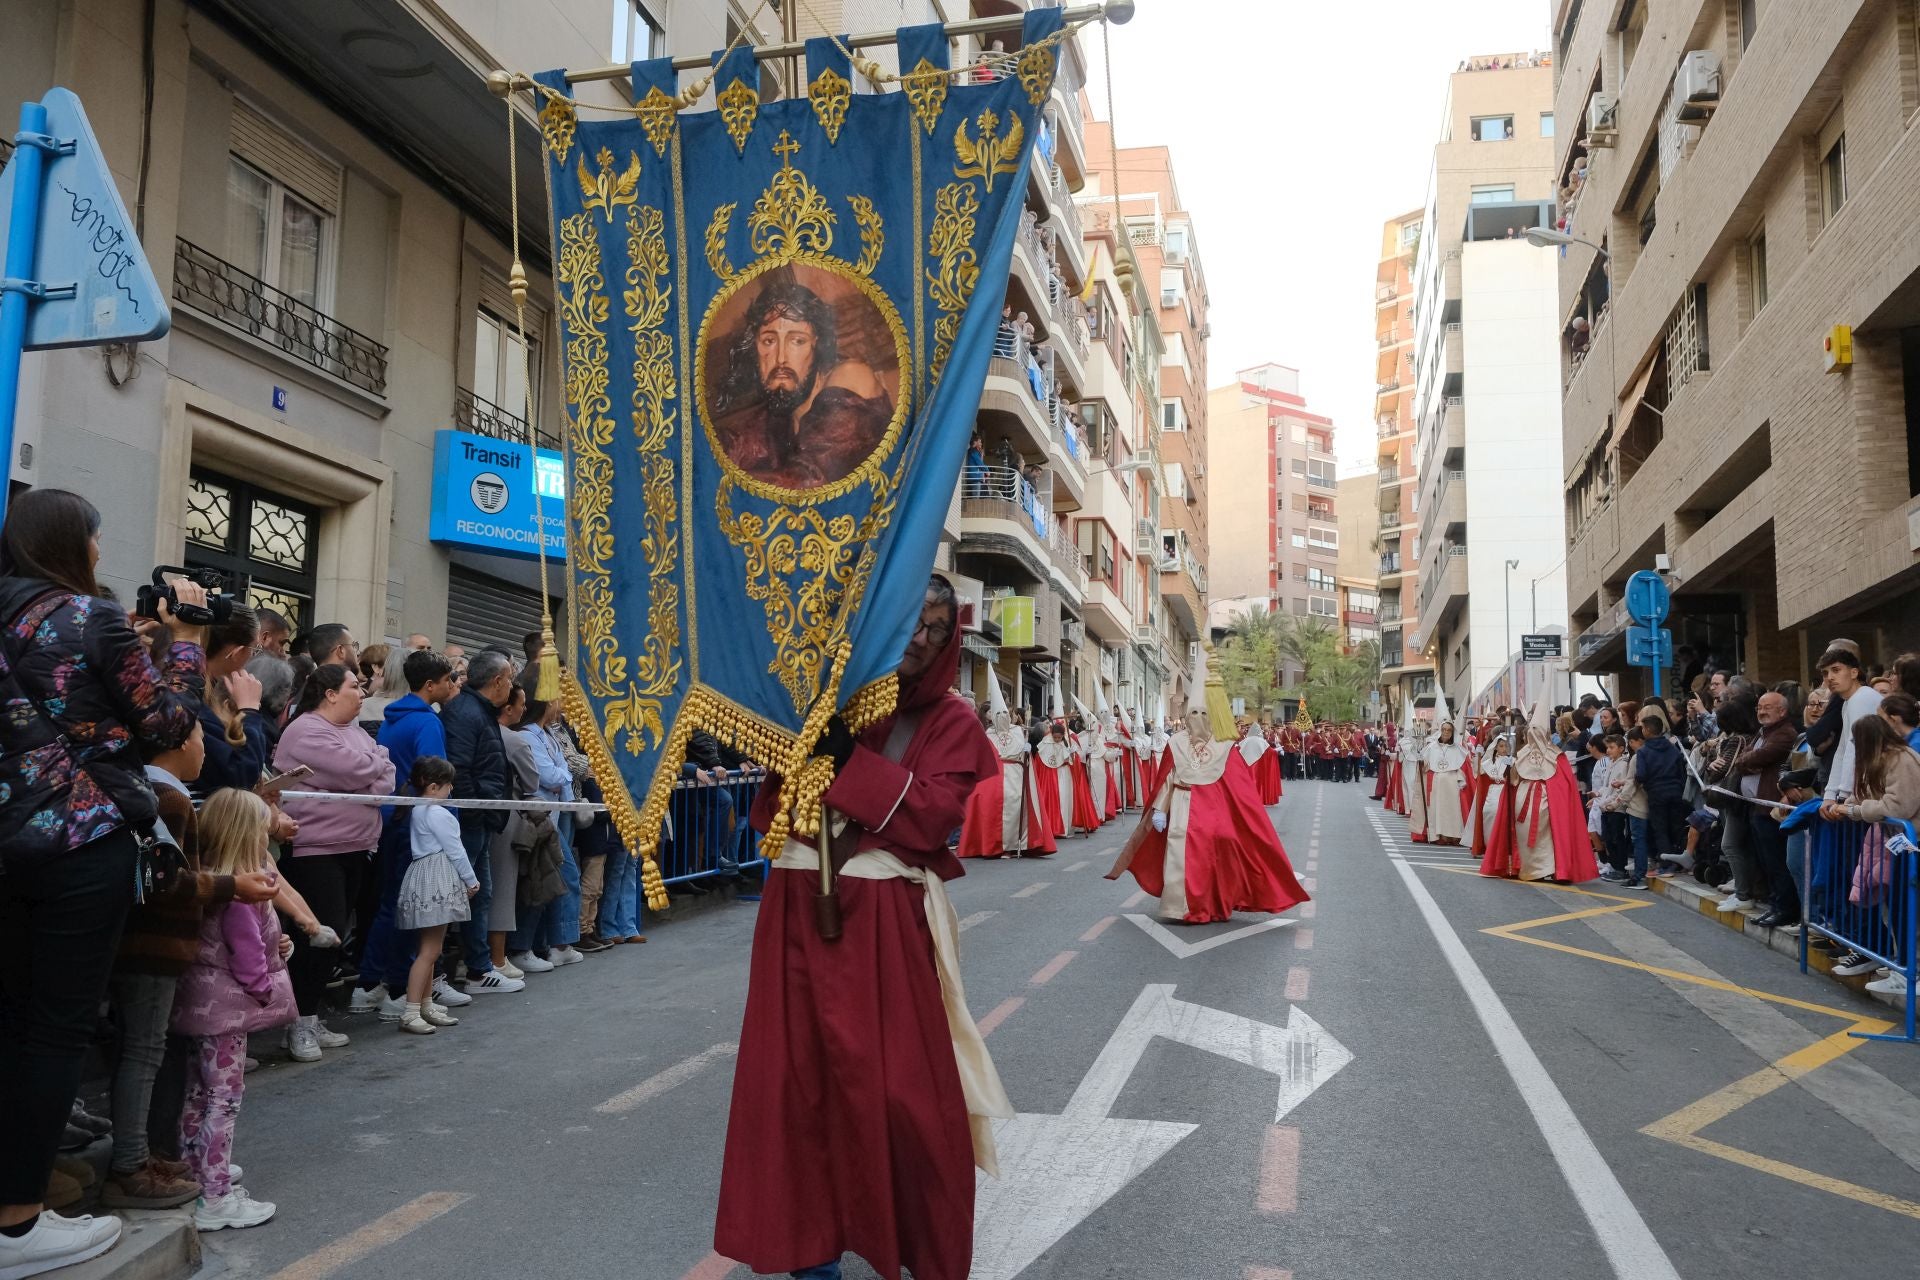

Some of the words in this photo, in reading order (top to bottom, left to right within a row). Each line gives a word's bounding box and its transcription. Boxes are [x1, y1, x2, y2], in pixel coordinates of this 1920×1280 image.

[278, 391, 285, 407] 9
[461, 441, 521, 469] Transit
[536, 459, 564, 471] Cen
[529, 514, 566, 527] FOTOCA
